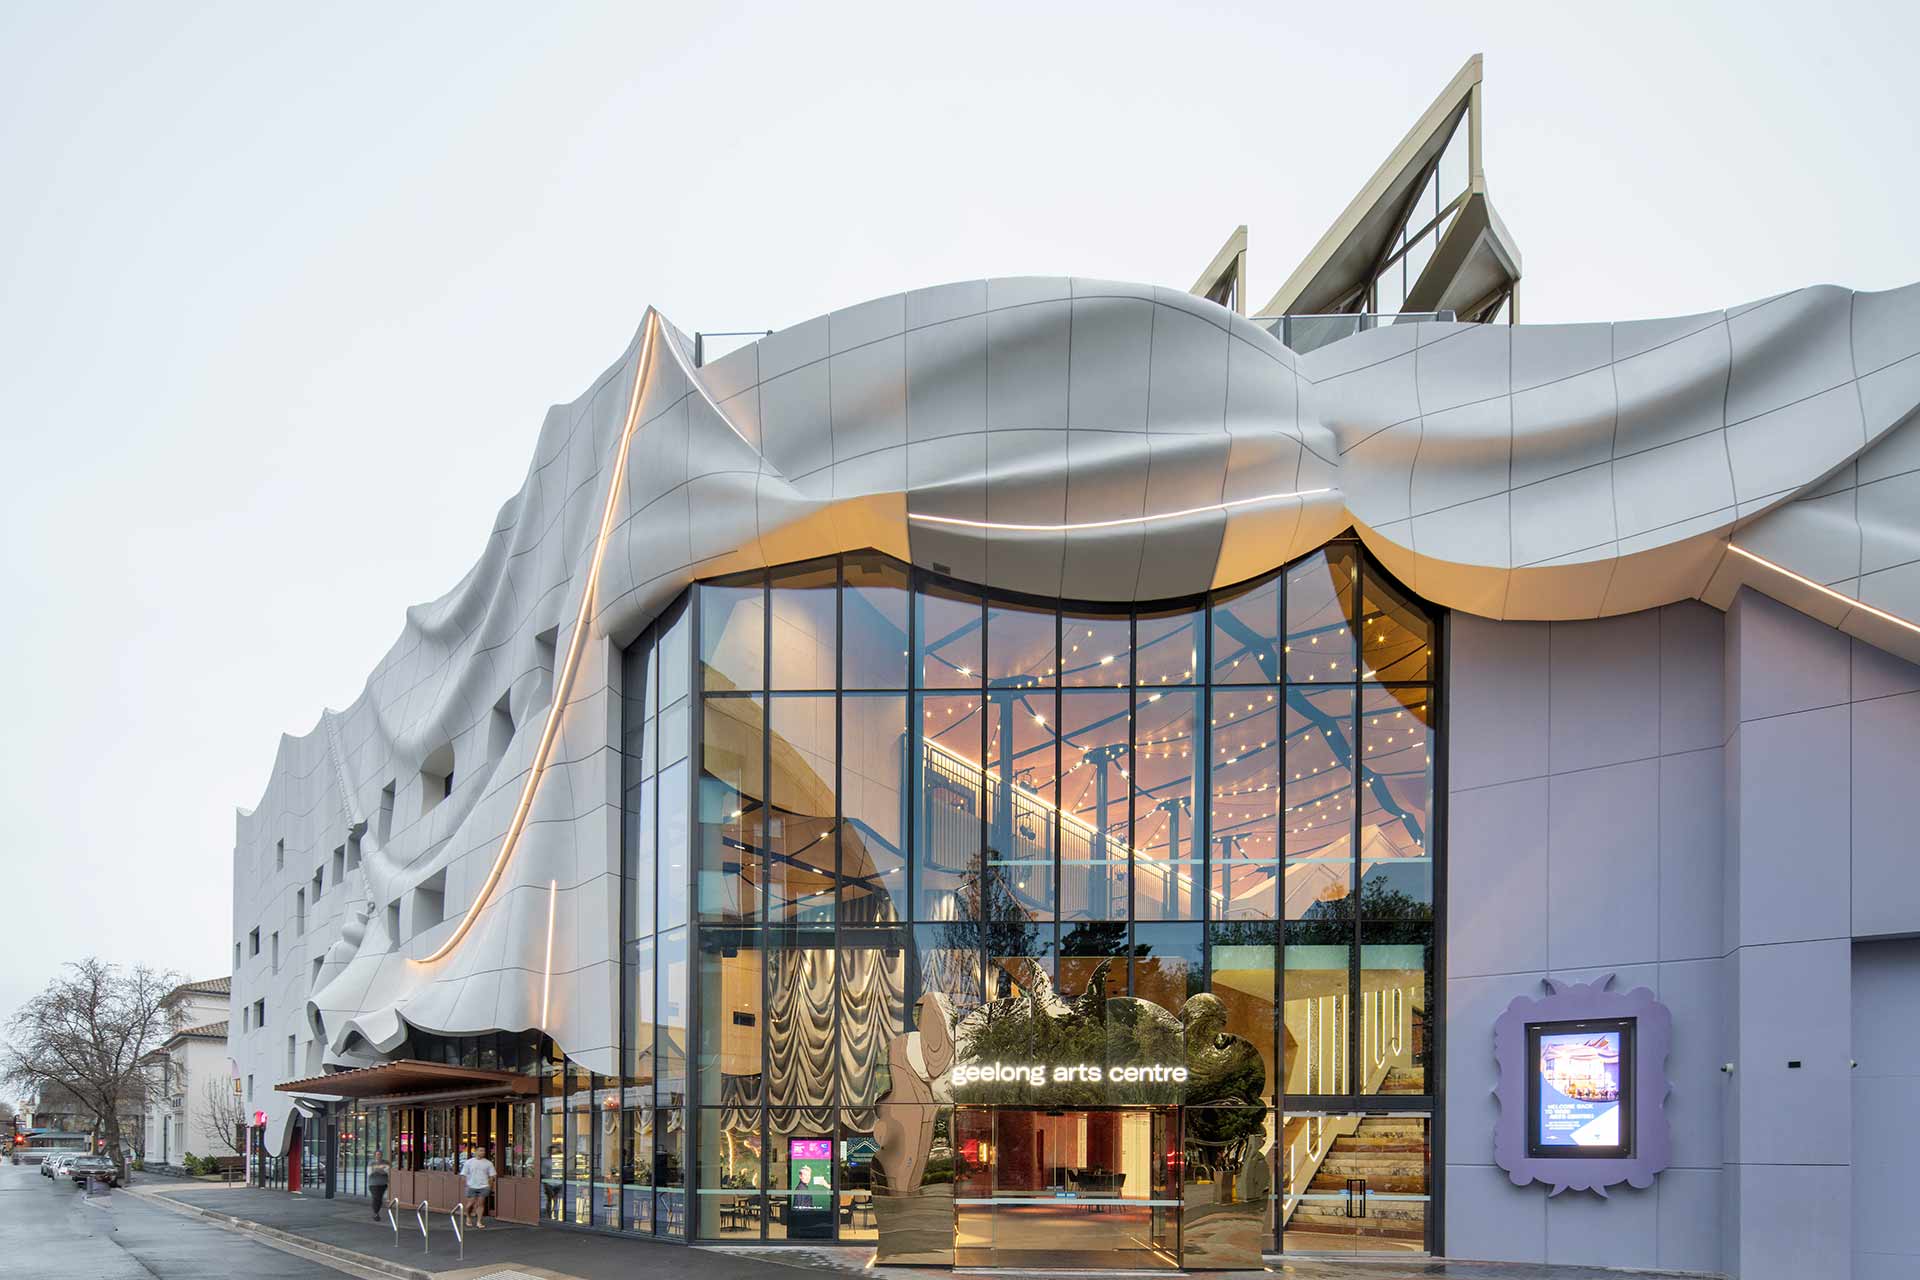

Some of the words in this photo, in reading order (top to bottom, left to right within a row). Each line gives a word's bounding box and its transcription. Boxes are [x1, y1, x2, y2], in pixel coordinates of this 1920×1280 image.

[951, 1062, 1046, 1086] geelong
[1053, 1064, 1102, 1082] arts
[1109, 1063, 1188, 1082] centre
